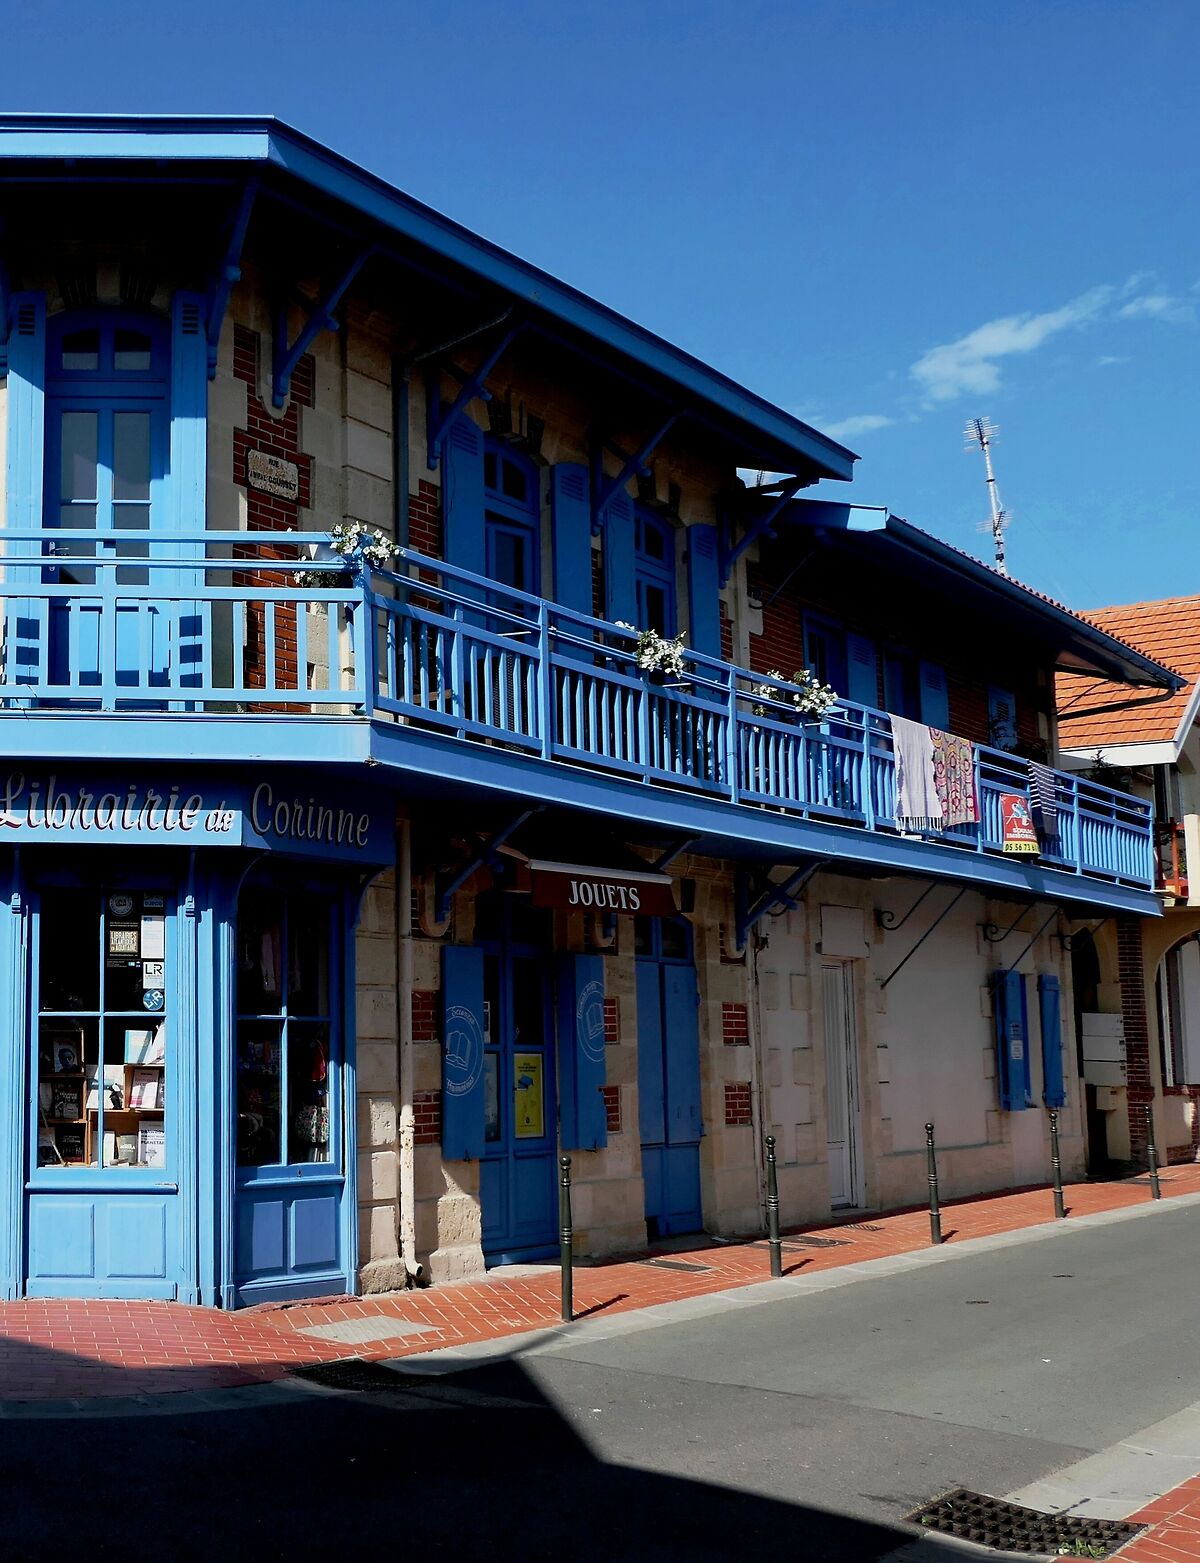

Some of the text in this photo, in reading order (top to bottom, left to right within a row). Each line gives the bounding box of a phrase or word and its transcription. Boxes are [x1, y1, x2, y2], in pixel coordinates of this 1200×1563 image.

[205, 807, 235, 834] de
[249, 782, 370, 848] Corinne
[568, 879, 641, 911] JOUETS
